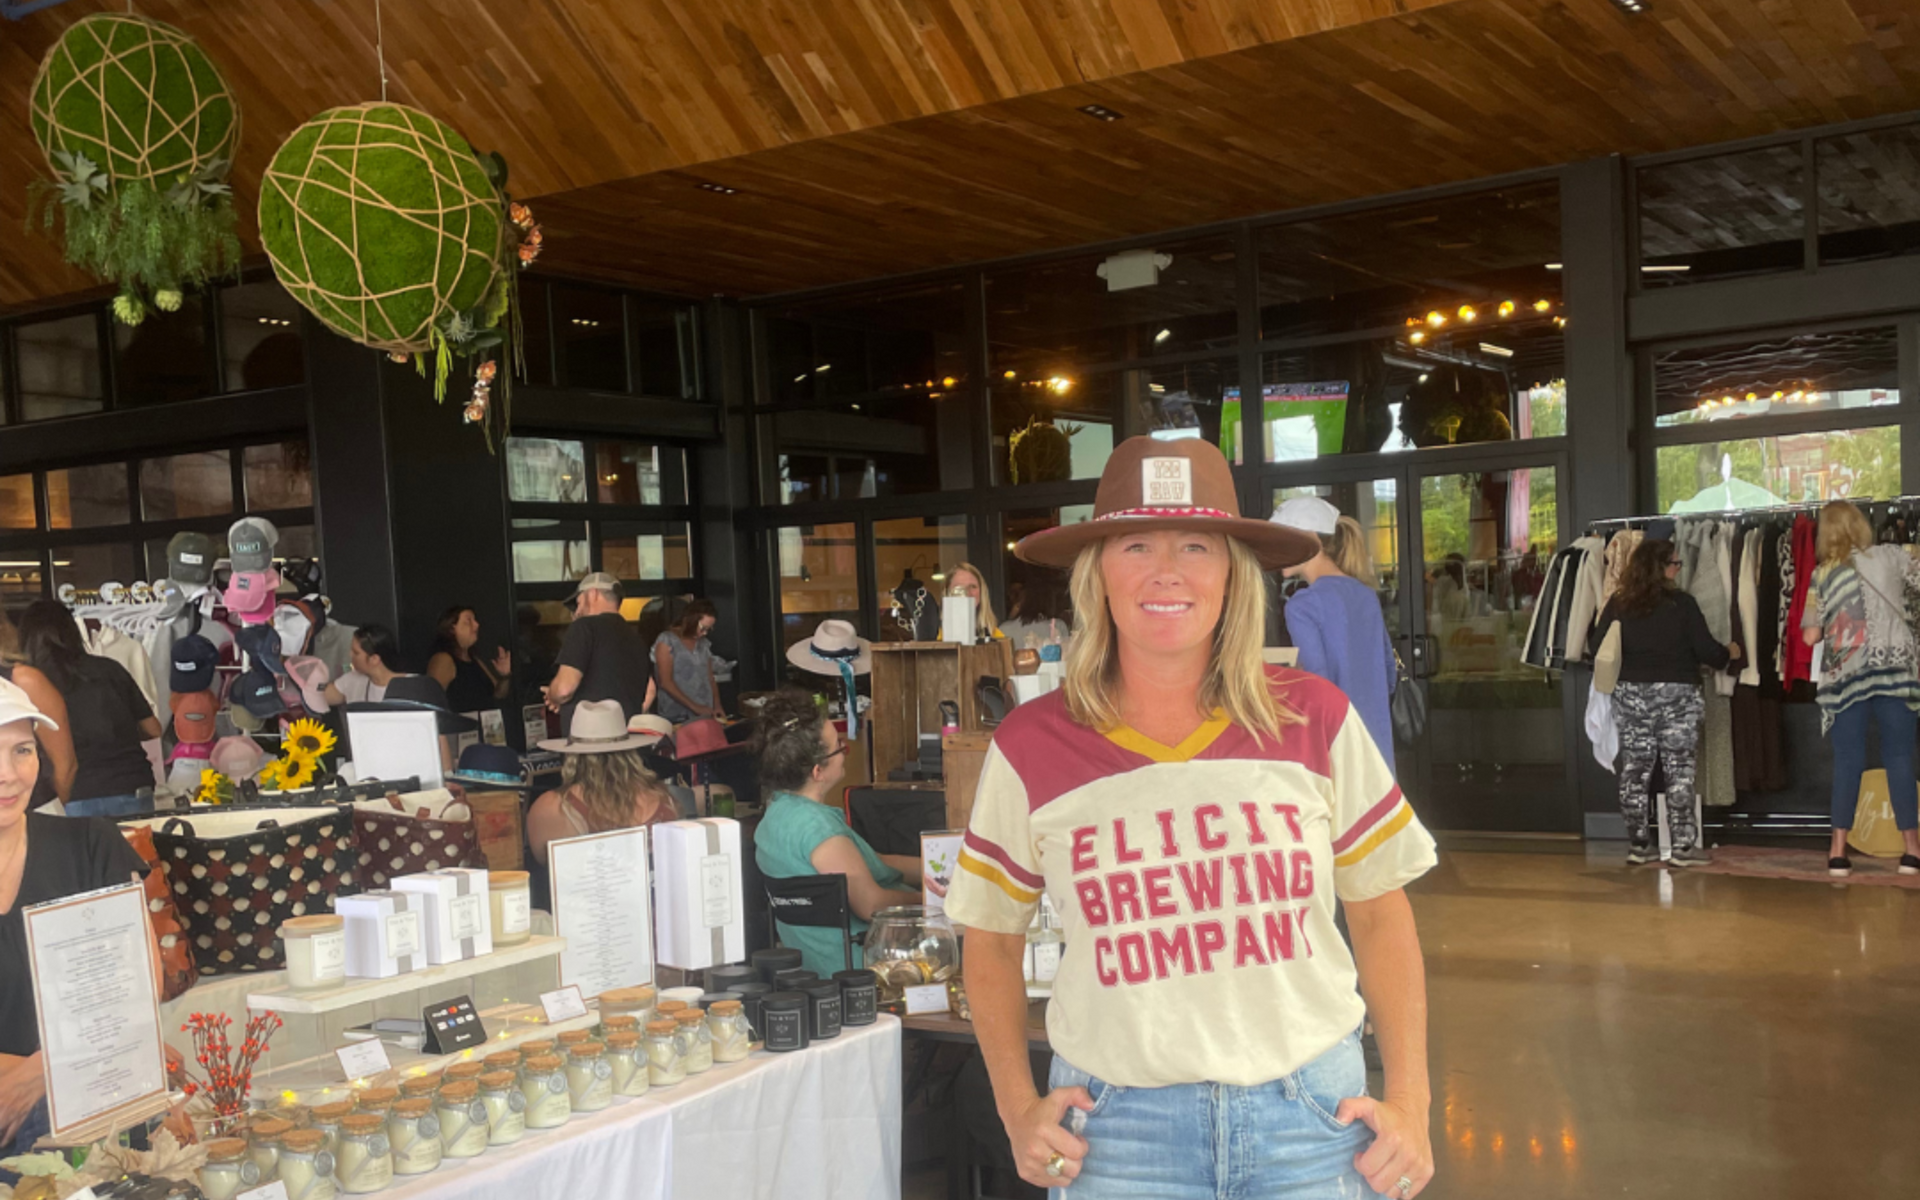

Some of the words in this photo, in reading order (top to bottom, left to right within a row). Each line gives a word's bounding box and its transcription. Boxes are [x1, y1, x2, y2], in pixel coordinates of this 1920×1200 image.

[1150, 481, 1185, 500] HAW
[1153, 460, 1181, 479] YEE
[1071, 801, 1305, 874] ELICIT
[1074, 849, 1314, 928] BREWING
[1095, 906, 1313, 988] COMPANY
